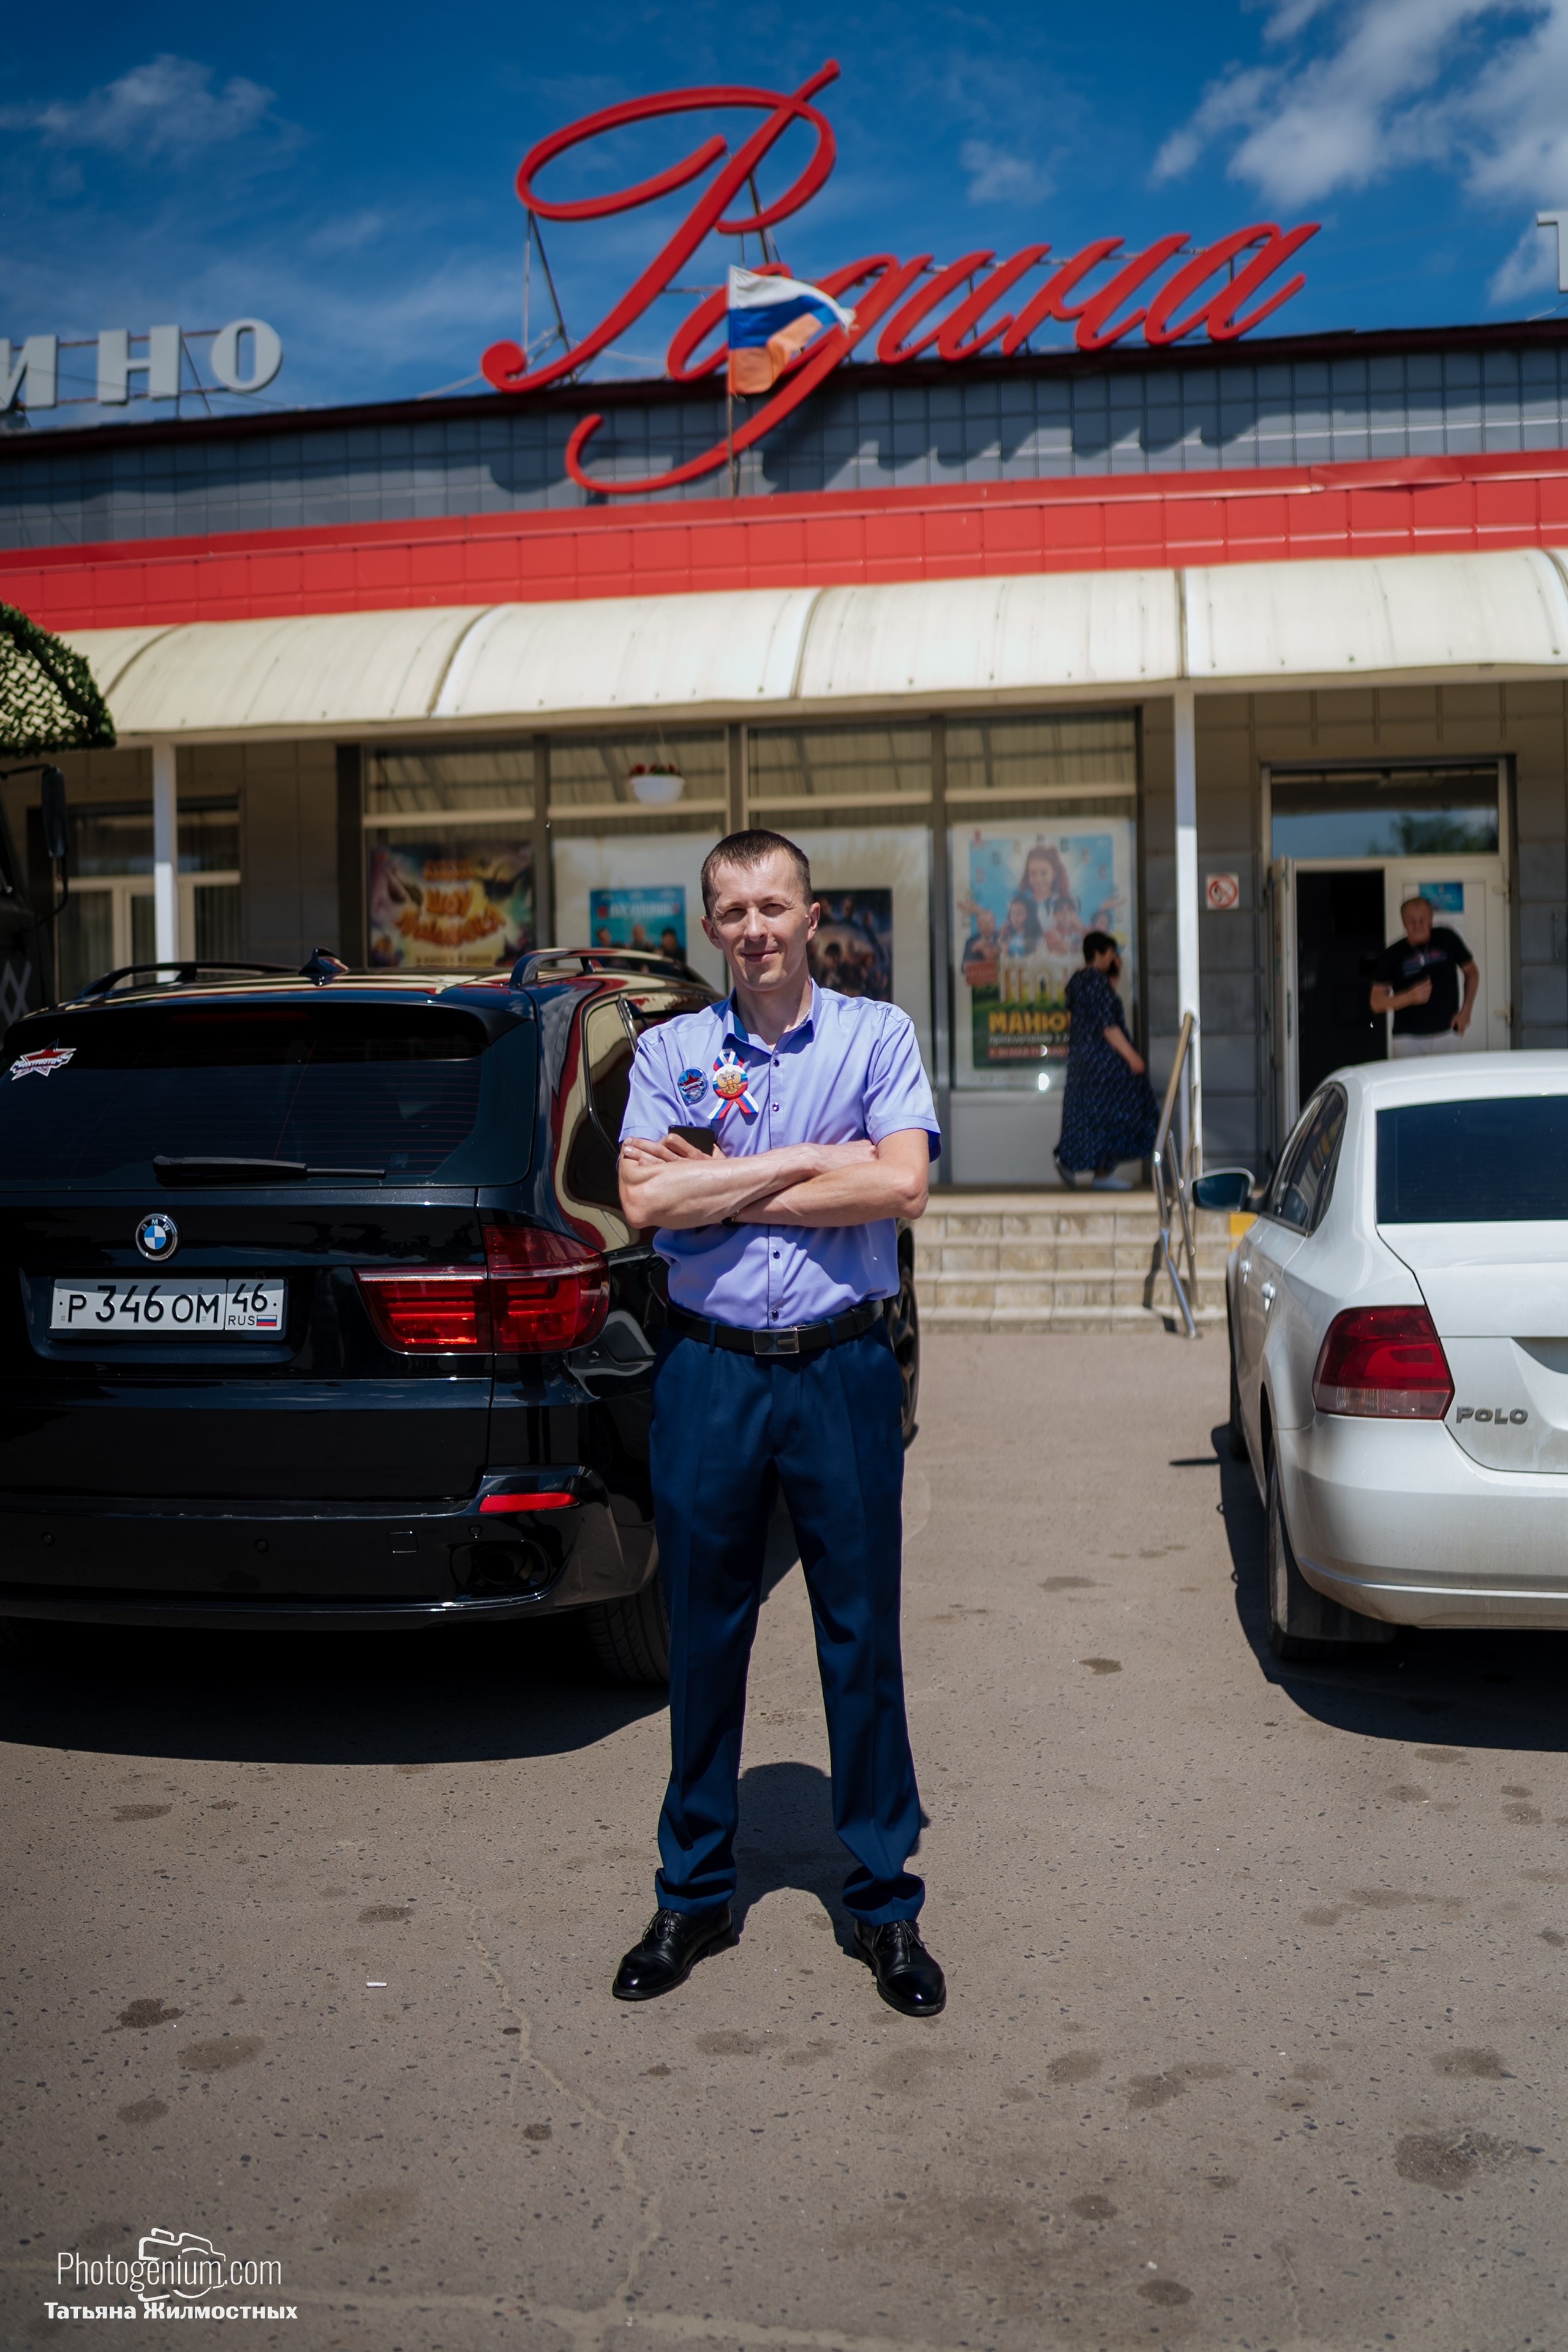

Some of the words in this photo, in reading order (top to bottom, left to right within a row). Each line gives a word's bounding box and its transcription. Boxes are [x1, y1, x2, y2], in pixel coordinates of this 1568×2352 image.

[481, 59, 1321, 494] Родина
[0, 317, 284, 412] ИНО
[141, 1218, 171, 1232] BMW
[232, 1283, 269, 1313] 46
[228, 1314, 255, 1326] RUS
[1456, 1406, 1529, 1425] POLO
